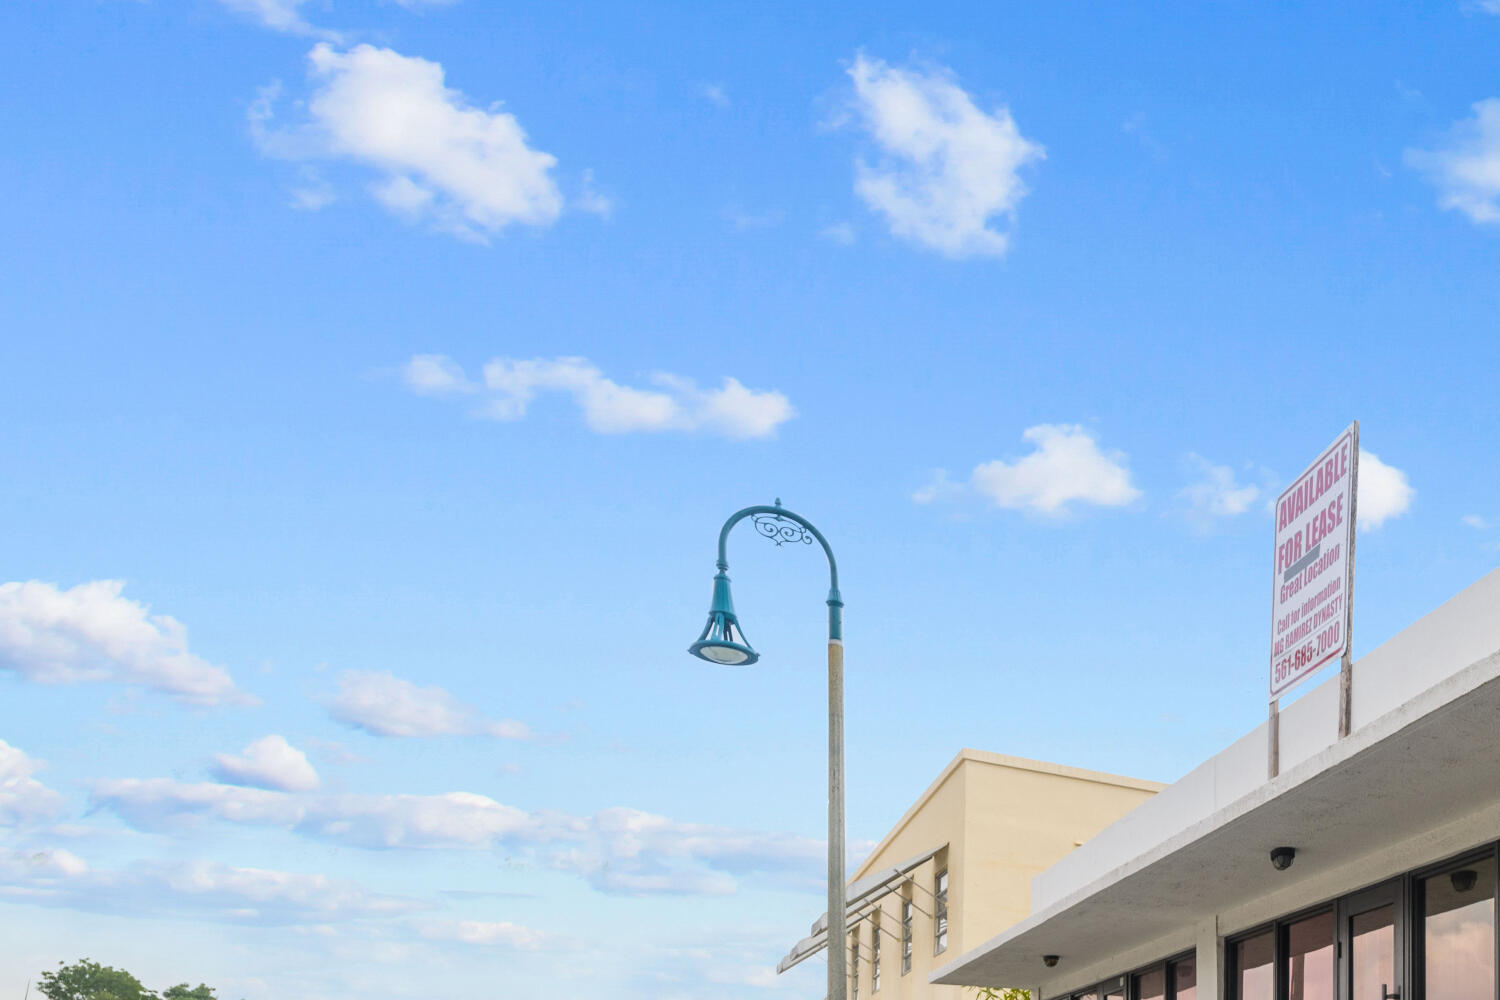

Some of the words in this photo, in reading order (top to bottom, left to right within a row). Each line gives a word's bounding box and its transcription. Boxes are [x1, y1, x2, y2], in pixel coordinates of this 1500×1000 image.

[1278, 442, 1347, 532] AVAILABLE
[1277, 530, 1302, 575] FOR
[1305, 492, 1343, 554] LEASE
[1277, 608, 1290, 635] Call
[1291, 606, 1301, 626] for
[1301, 576, 1341, 618] information
[1280, 572, 1302, 604] Great
[1304, 543, 1340, 587] Location
[1274, 636, 1284, 658] MG
[1285, 616, 1313, 649] RAMIREZ
[1313, 592, 1343, 629] DYNASTY
[1275, 620, 1341, 684] 561-685-7000
